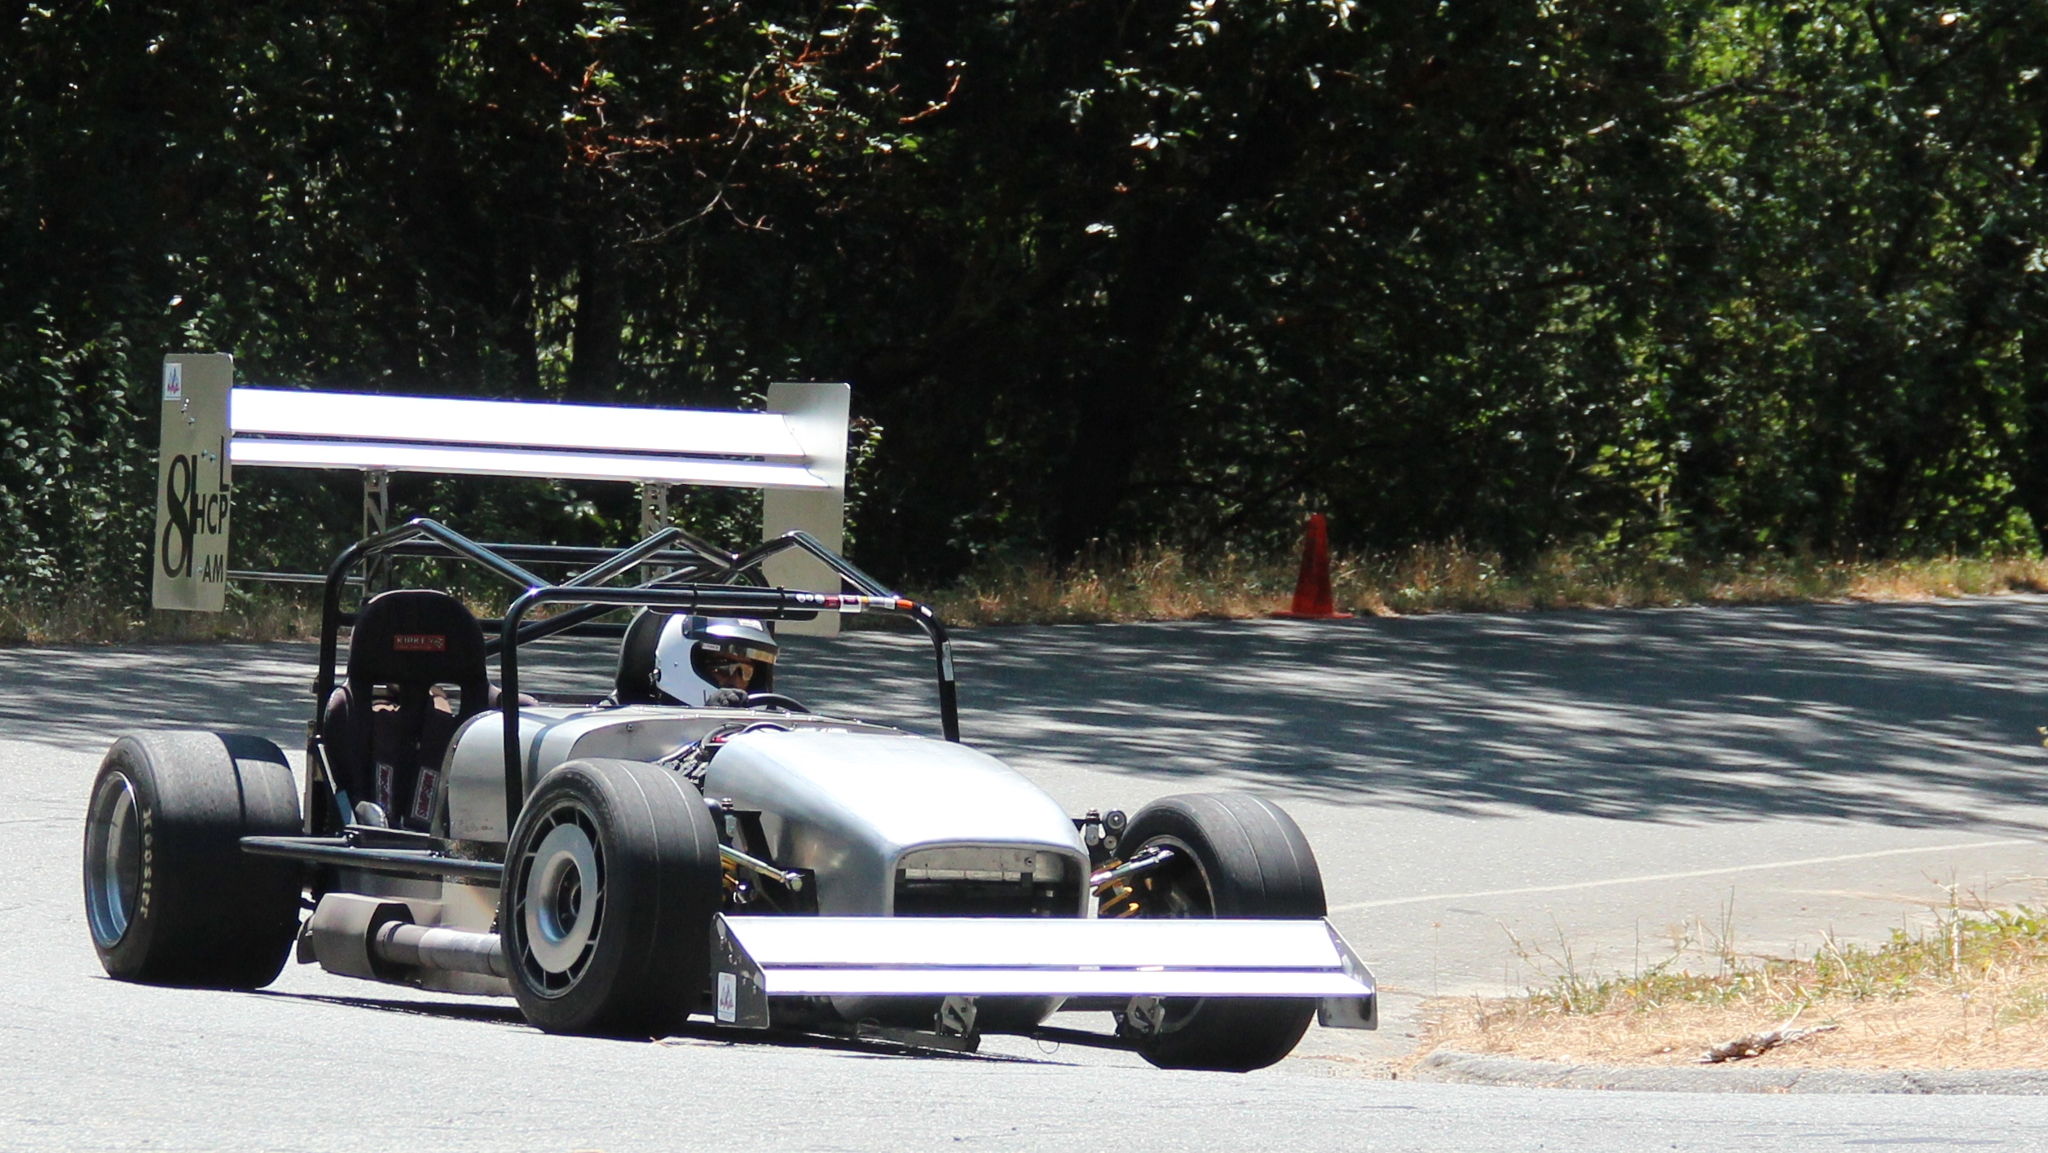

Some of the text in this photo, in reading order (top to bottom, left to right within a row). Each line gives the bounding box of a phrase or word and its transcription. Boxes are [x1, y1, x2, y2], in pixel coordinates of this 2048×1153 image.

[162, 454, 198, 578] 81
[193, 493, 229, 535] HCP
[202, 554, 224, 583] AM
[140, 807, 153, 919] Hoosier
